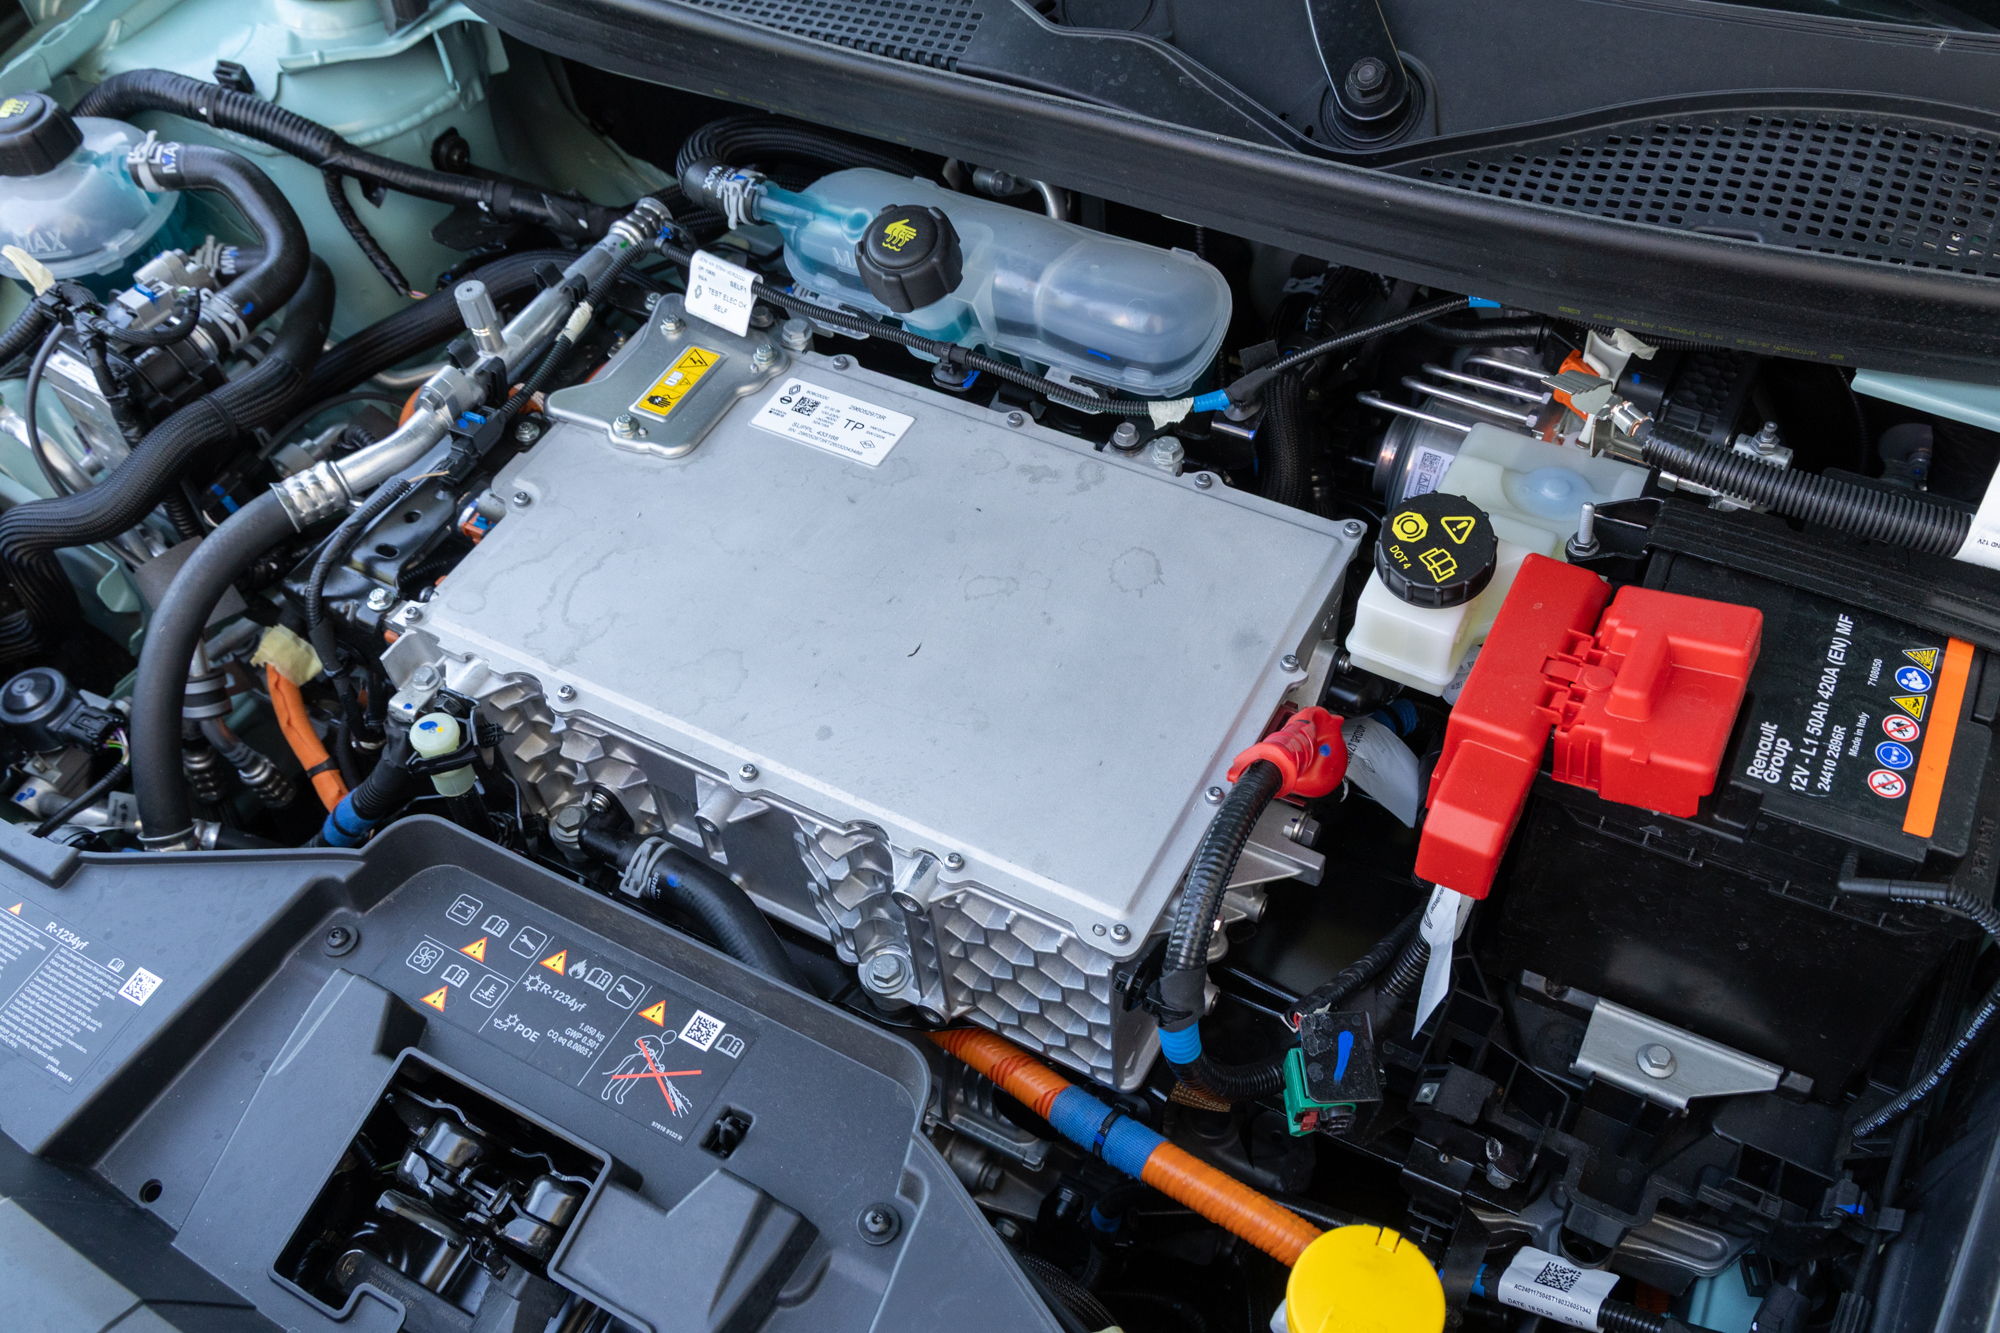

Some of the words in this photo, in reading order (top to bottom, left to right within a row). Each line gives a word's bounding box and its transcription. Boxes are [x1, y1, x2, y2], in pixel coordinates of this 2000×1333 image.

[703, 166, 722, 190] MAX
[13, 228, 67, 252] MAX
[708, 287, 722, 298] TEST
[723, 294, 738, 306] ELEC
[738, 301, 748, 310] OK
[713, 303, 728, 314] SELF
[843, 418, 865, 432] TP
[1389, 544, 1409, 563] DOT
[1835, 613, 1854, 637] MF
[1827, 637, 1851, 664] (EN)
[1817, 668, 1839, 699] 420A
[1867, 658, 1882, 685] 7108050
[1806, 701, 1828, 735] 50Ah
[1856, 711, 1869, 727] Italy
[1825, 724, 1844, 757] 2896R
[1853, 728, 1863, 736] in
[1746, 722, 1777, 778] Renault
[1799, 737, 1818, 755] L1
[1848, 736, 1861, 756] Made
[1763, 737, 1792, 783] Group
[1790, 764, 1809, 790] 12V
[1816, 758, 1835, 790] 24410
[45, 921, 89, 950] R-1234yf
[539, 982, 586, 1011] R-1234yf
[514, 1023, 539, 1042] POE
[579, 1022, 595, 1036] 1.050
[594, 1031, 606, 1042] kg
[565, 1027, 582, 1039] GWP
[581, 1035, 601, 1050] 0.501
[566, 1040, 590, 1057] 0.0005
[1937, 1039, 1967, 1074] 31.01.2025
[1507, 1297, 1527, 1309] DATE:
